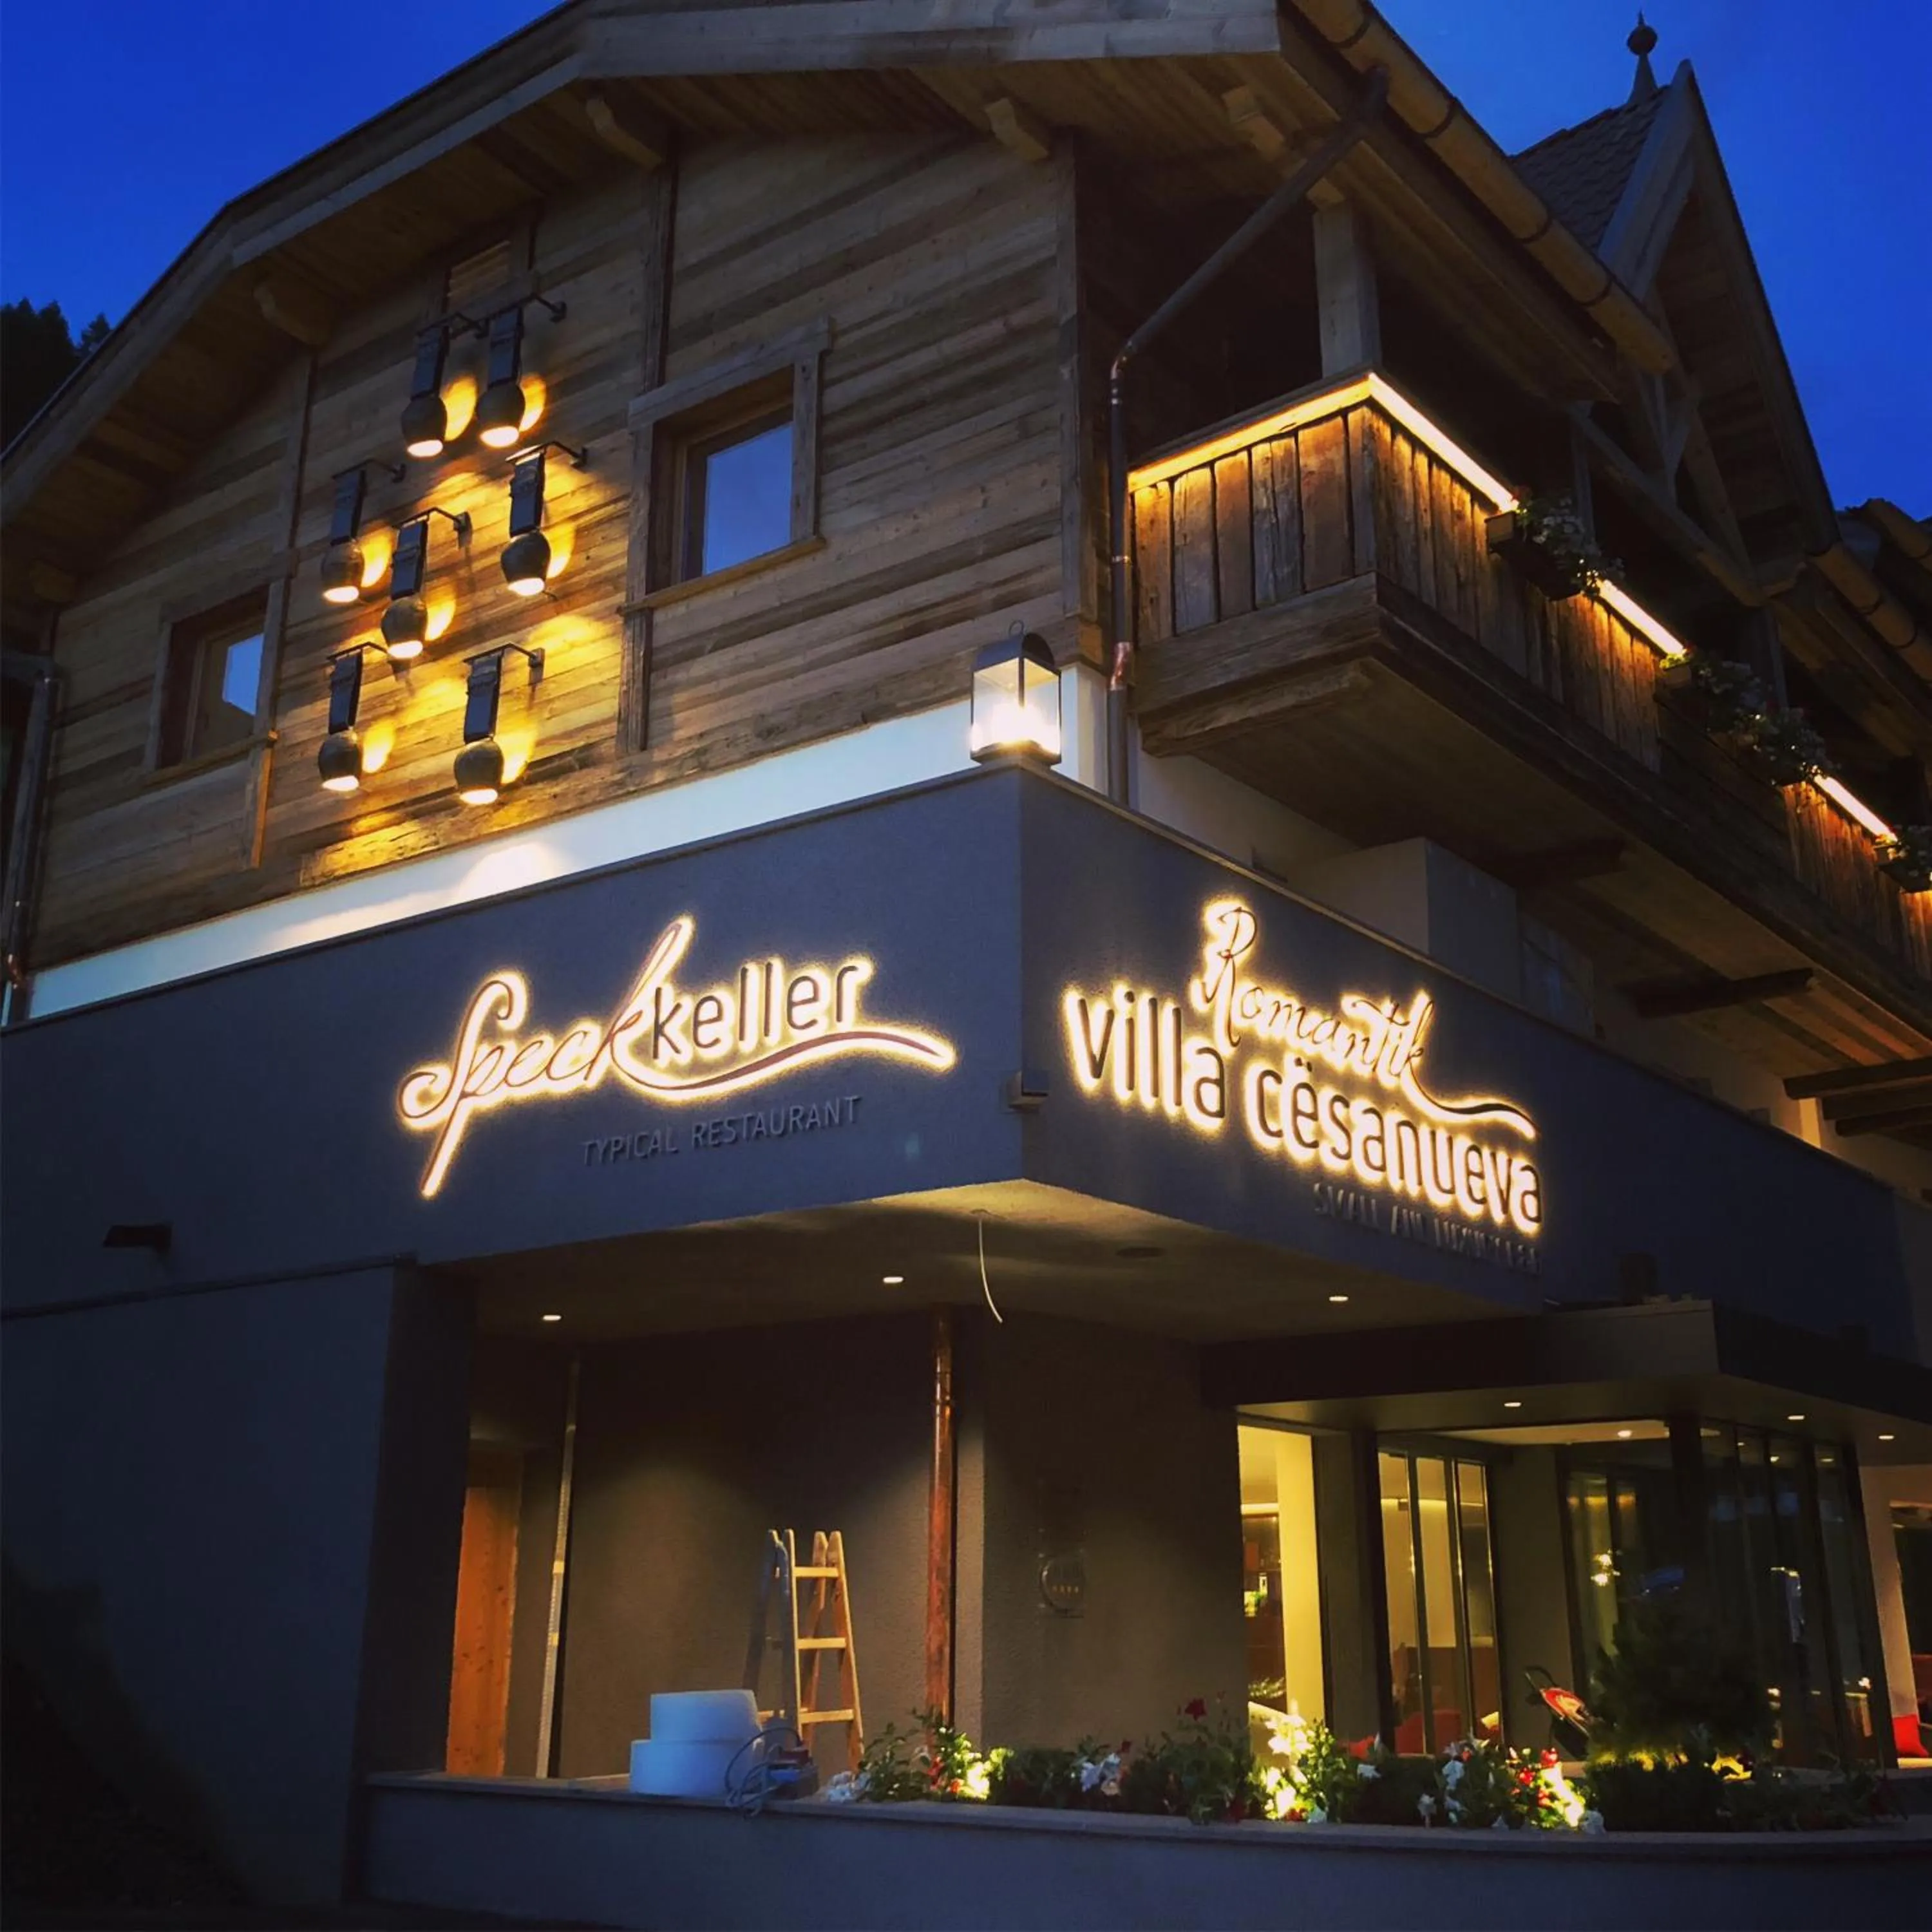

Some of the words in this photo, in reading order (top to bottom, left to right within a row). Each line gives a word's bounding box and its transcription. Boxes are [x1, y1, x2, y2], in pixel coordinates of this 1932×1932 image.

[1194, 904, 1540, 1136] Romantik
[583, 1124, 679, 1166] TYPICAL
[691, 1095, 861, 1149] RESTAURANT
